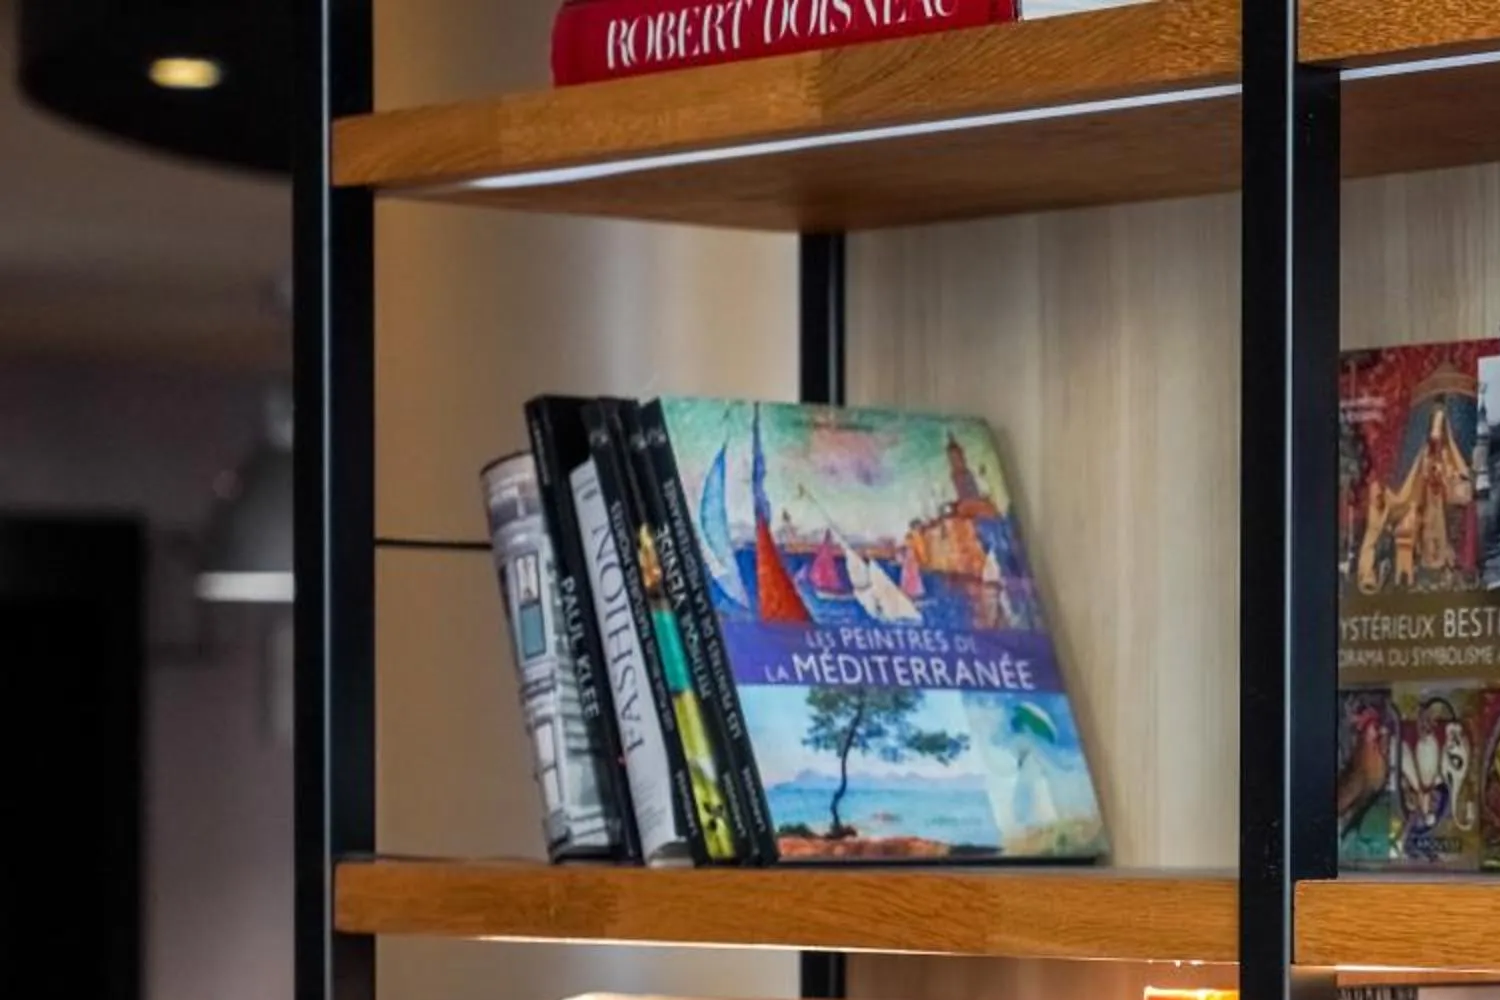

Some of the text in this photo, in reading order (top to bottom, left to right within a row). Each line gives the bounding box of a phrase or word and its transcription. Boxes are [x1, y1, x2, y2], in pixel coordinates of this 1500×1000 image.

[605, 0, 753, 69] ROBERT
[651, 522, 689, 610] VENISE
[560, 575, 602, 718] PAUL KLEE
[591, 524, 645, 752] FASHION
[764, 646, 1037, 690] LA MÉDITERRANÉE
[804, 629, 836, 649] LES
[840, 626, 949, 653] PEINTRES
[725, 711, 742, 738] LES
